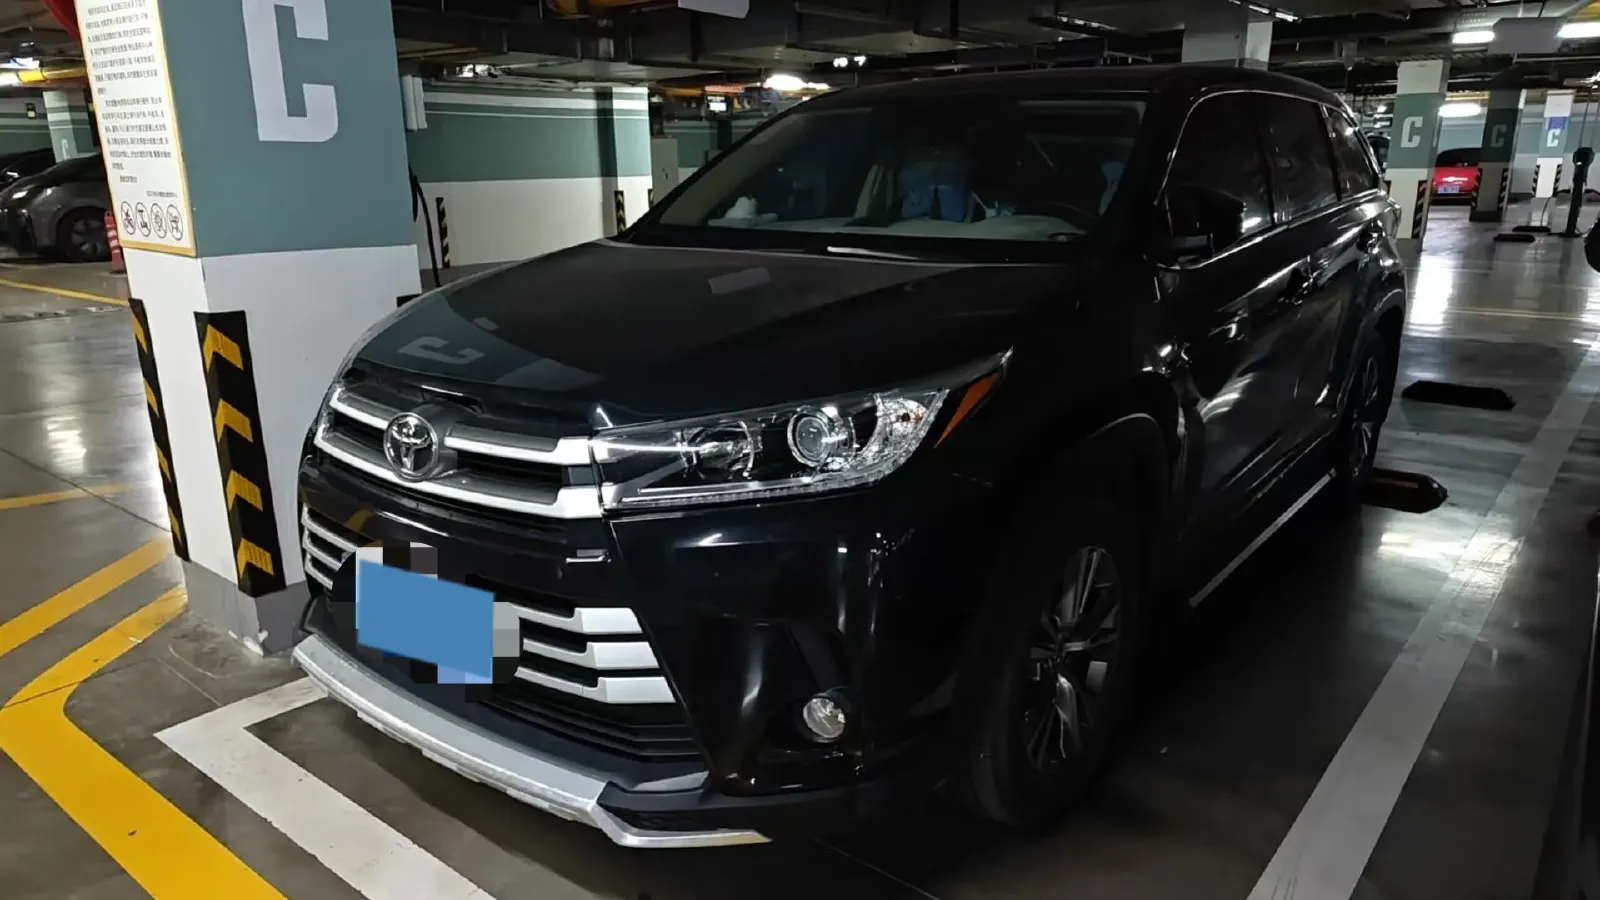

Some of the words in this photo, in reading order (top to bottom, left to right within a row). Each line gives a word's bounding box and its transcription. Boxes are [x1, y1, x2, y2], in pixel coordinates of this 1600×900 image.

[242, 0, 338, 142] C
[1400, 117, 1423, 147] C
[1490, 124, 1507, 147] C
[1547, 129, 1560, 147] C
